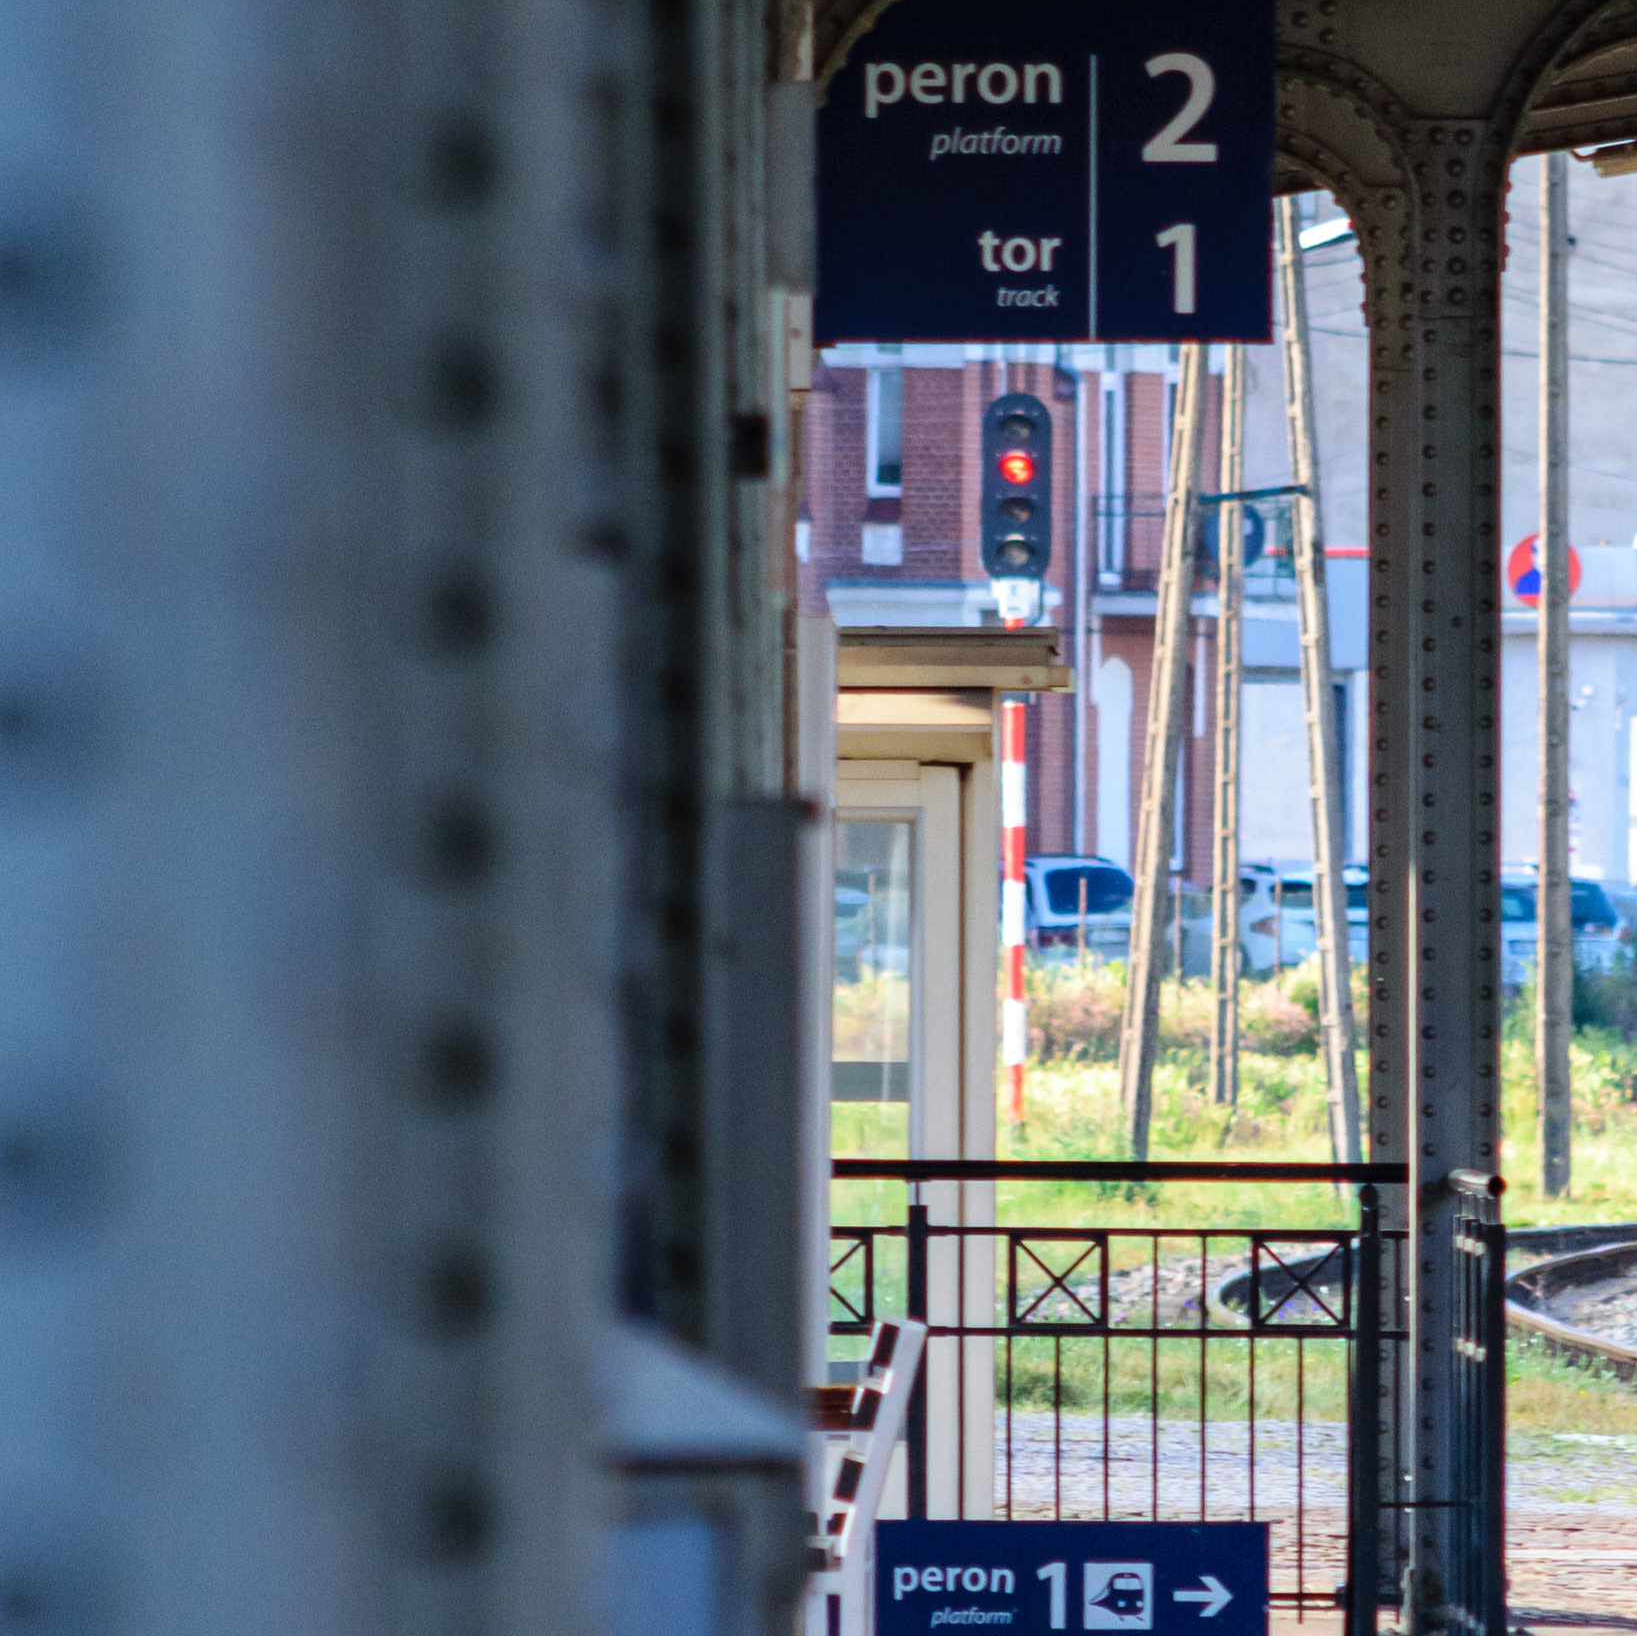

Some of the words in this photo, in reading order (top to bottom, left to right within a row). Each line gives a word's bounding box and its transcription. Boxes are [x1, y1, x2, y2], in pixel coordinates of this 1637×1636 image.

[865, 62, 1062, 119] peron
[1141, 52, 1218, 163] 2
[930, 126, 1062, 160] platform
[977, 230, 1061, 273] tor
[1156, 223, 1196, 315] 1
[996, 283, 1060, 308] track
[893, 1566, 1015, 1601] peron
[1036, 1562, 1067, 1630] 1
[930, 1606, 1013, 1629] platform
